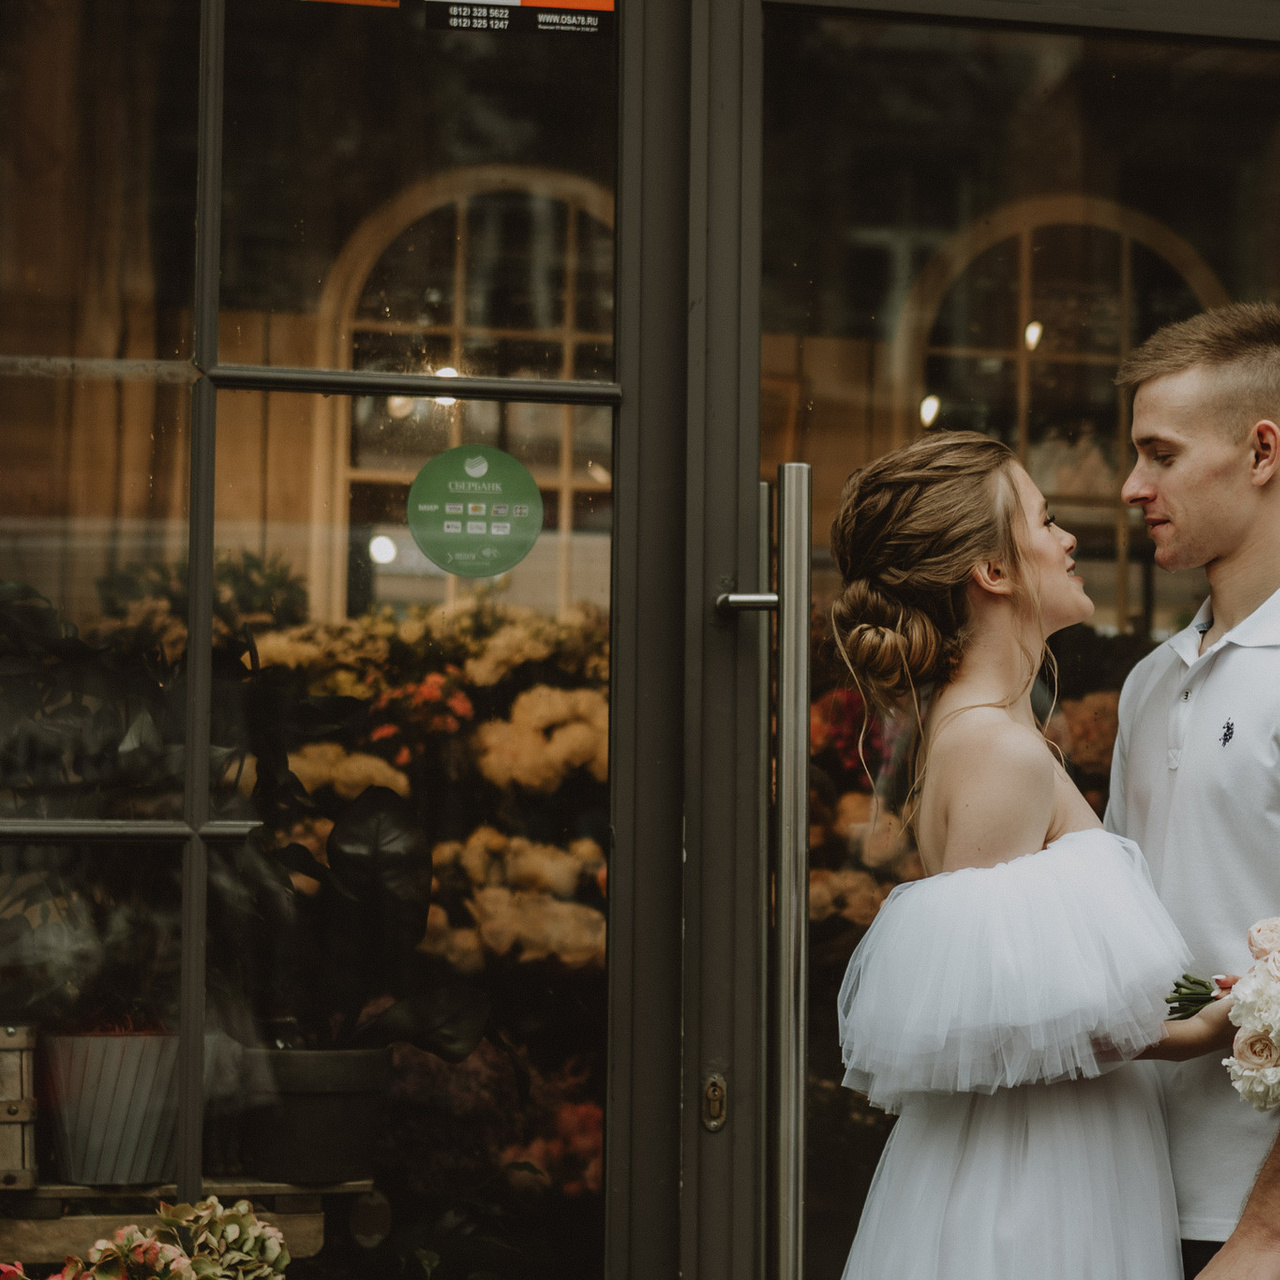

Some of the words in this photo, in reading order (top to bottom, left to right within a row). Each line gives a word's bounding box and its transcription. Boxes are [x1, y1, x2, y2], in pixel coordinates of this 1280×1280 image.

[449, 7, 471, 16] (812)
[472, 8, 488, 17] 328
[489, 9, 509, 19] 5622
[449, 18, 471, 27] (812)
[472, 19, 488, 28] 325
[490, 20, 509, 30] 1247
[538, 14, 598, 26] WWW.OSA78.RU
[448, 481, 502, 492] СБЕРБАНК
